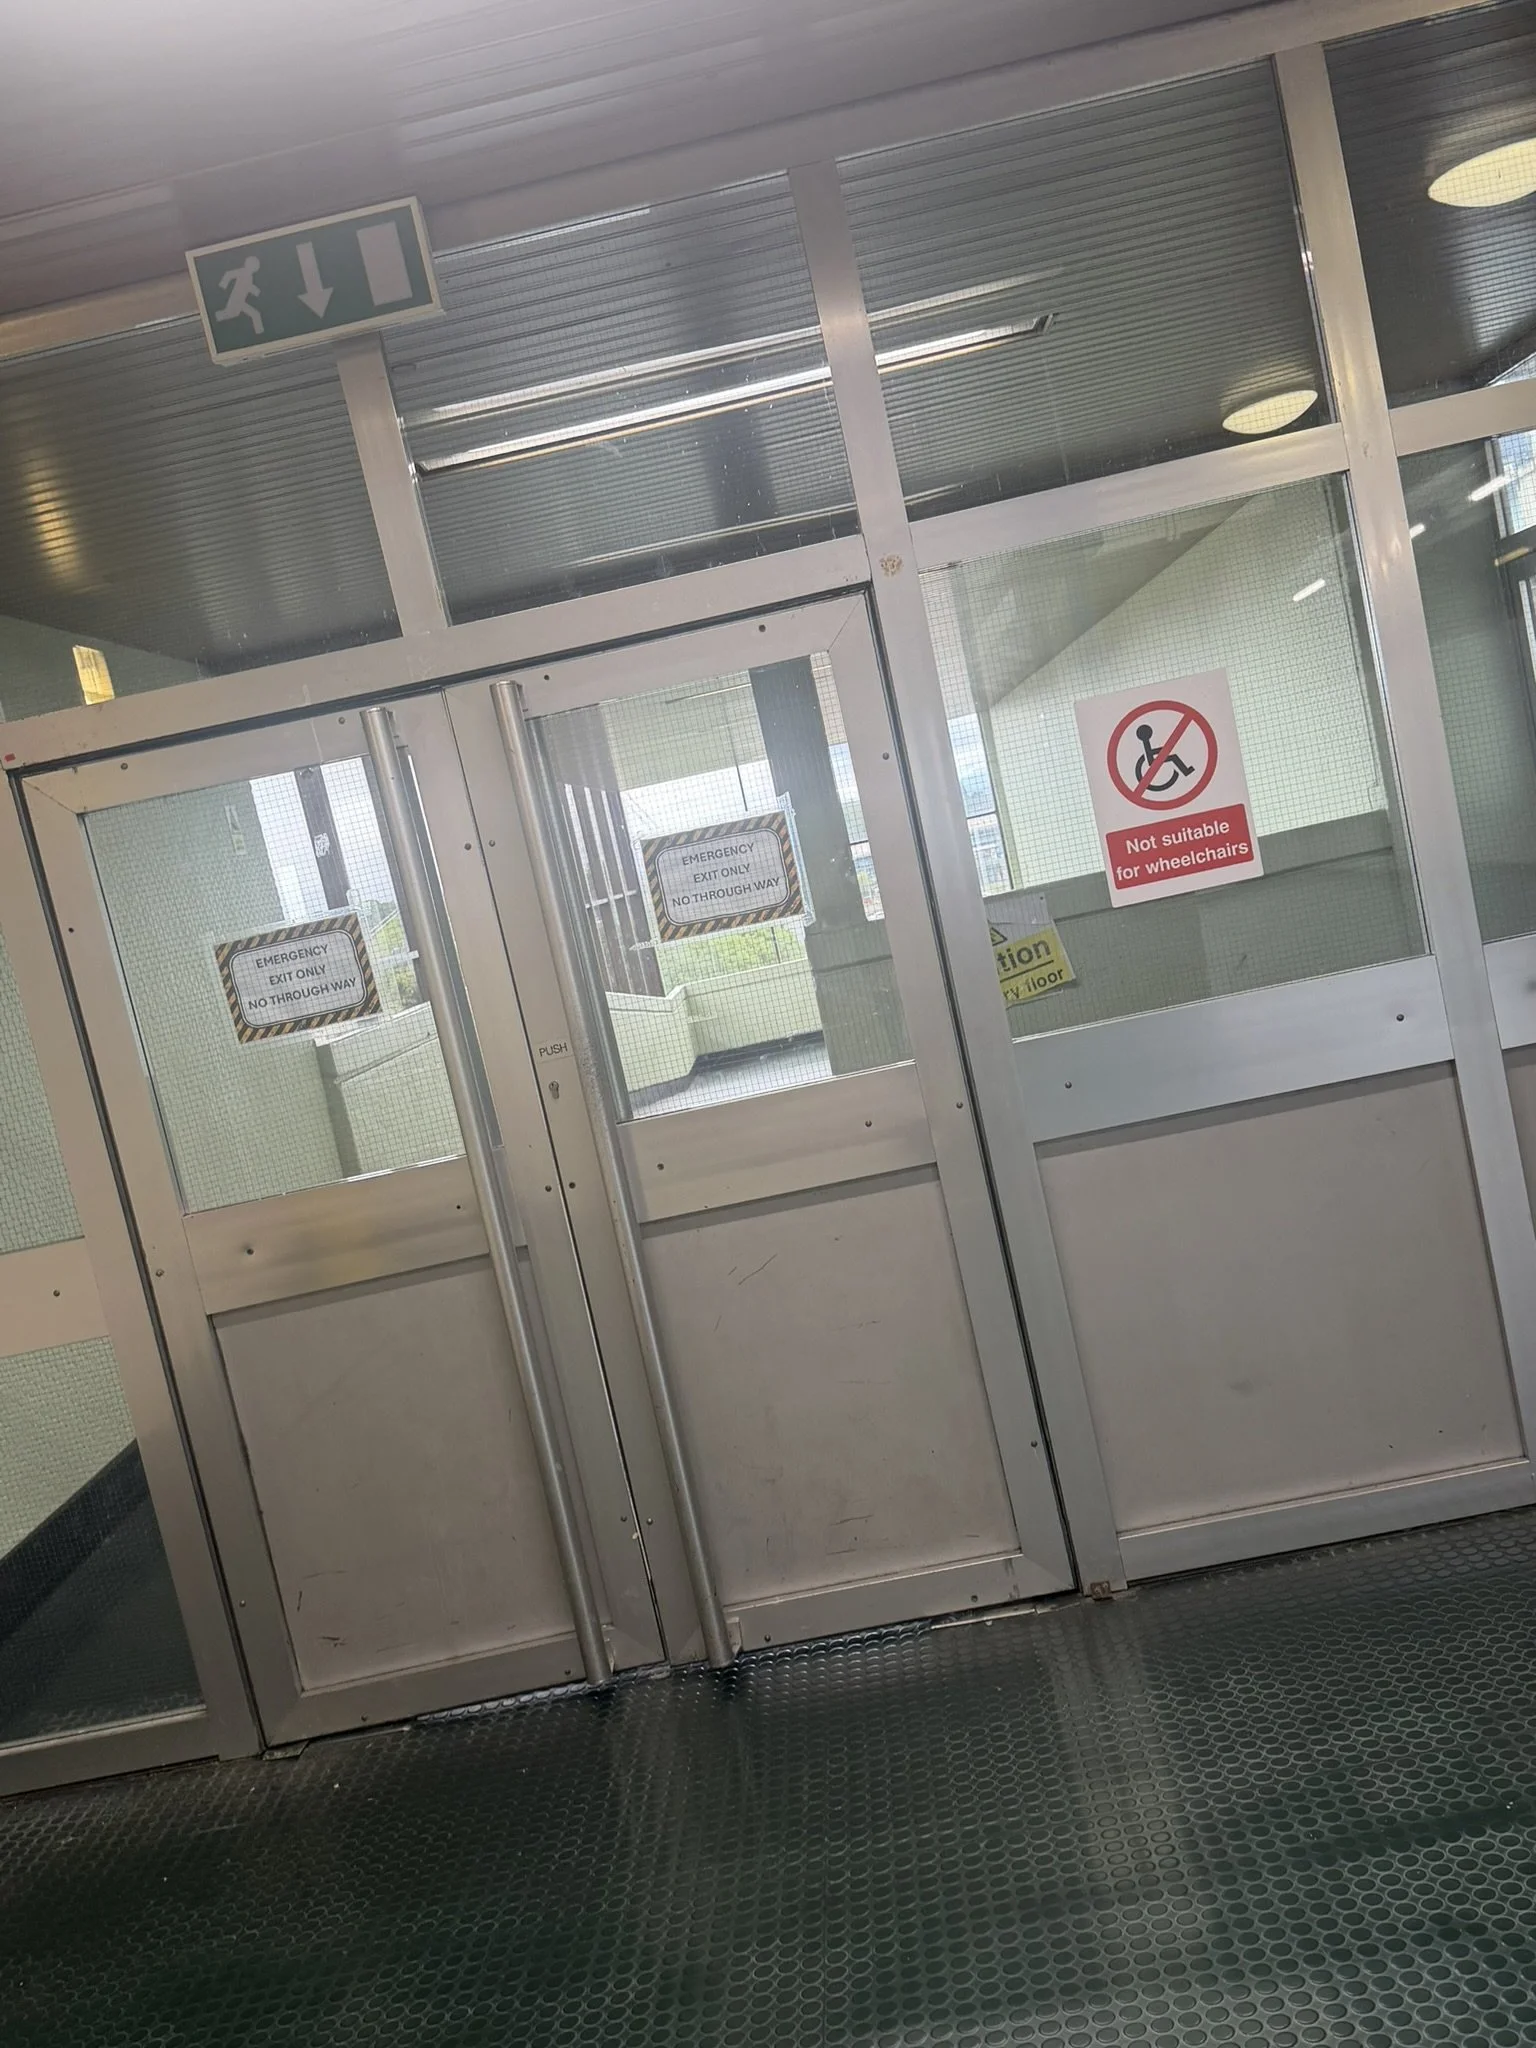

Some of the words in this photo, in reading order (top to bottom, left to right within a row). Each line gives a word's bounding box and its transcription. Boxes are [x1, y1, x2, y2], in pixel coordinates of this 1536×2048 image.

[1126, 835, 1157, 854] Not
[1162, 820, 1230, 847] suitable
[681, 843, 755, 866] EMERGENCY
[1116, 866, 1140, 881] for
[1145, 842, 1249, 874] wheelchairs
[693, 870, 719, 884] EXIT
[721, 863, 750, 878] ONLY
[672, 896, 690, 907] NO
[692, 884, 752, 903] THROUGH
[754, 877, 780, 892] WAY
[256, 944, 329, 969] EMERGENCY
[997, 940, 1050, 972] tion
[269, 972, 293, 986] EXIT
[296, 965, 326, 980] ONLY
[1026, 968, 1063, 992] floor
[248, 998, 268, 1010] NO
[269, 986, 329, 1006] THROUGH
[330, 977, 357, 992] WAY
[539, 1042, 568, 1057] PUSH
